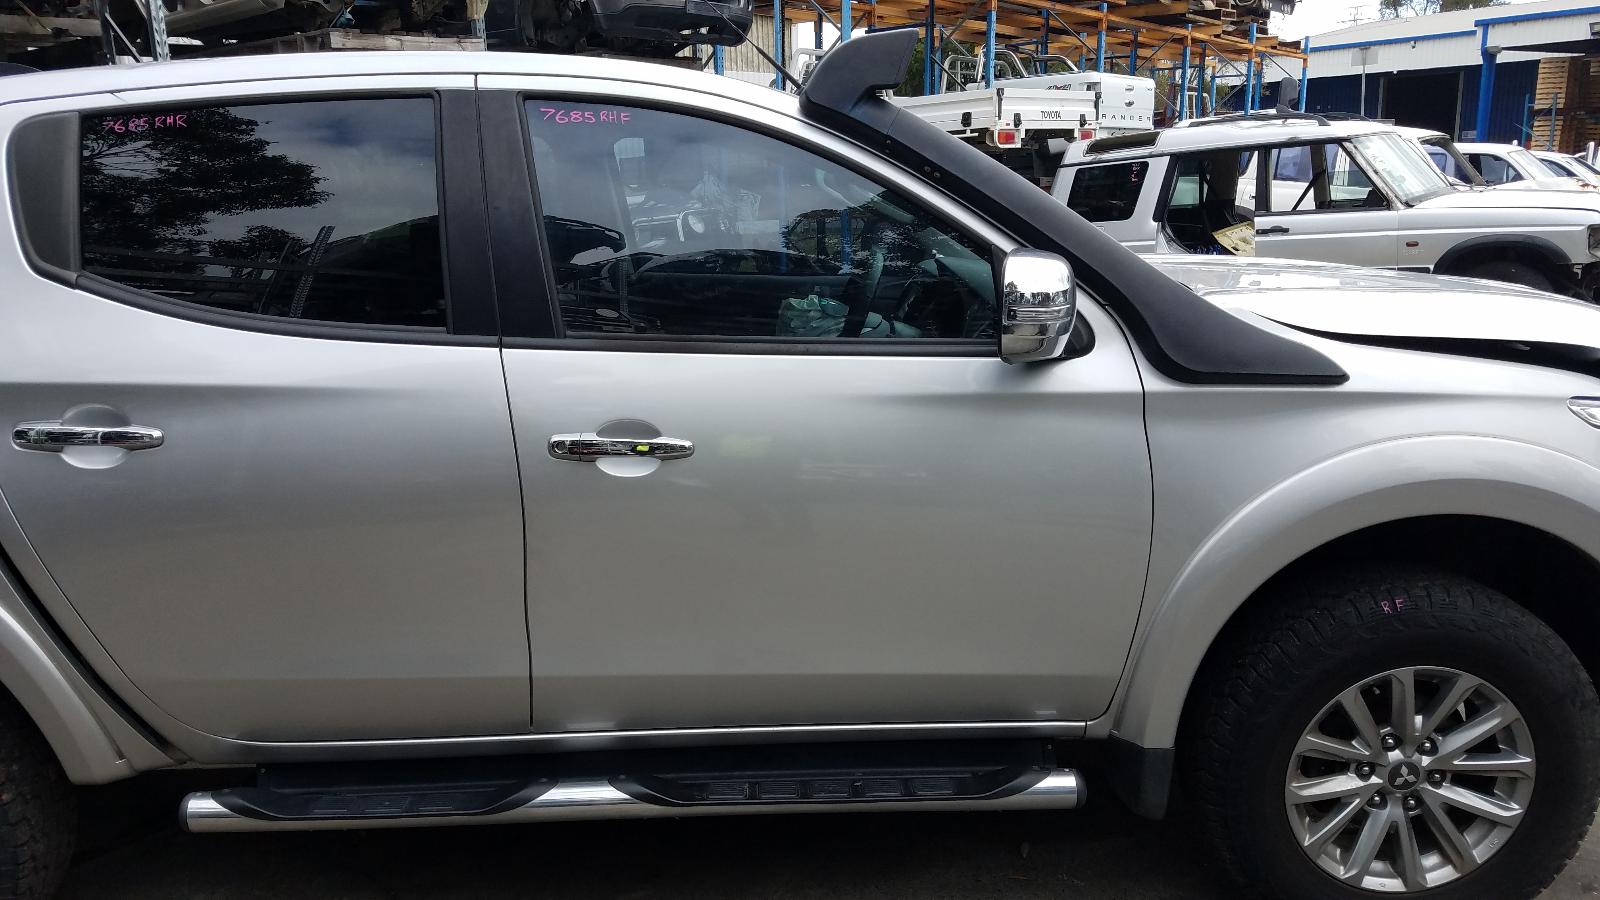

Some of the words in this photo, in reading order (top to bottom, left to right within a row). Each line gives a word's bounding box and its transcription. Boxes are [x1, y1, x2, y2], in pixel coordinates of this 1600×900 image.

[540, 108, 596, 124] 7685
[600, 110, 631, 124] RHF
[1040, 110, 1062, 120] TOYOTA
[101, 117, 149, 134] 7685
[154, 114, 187, 128] RHR
